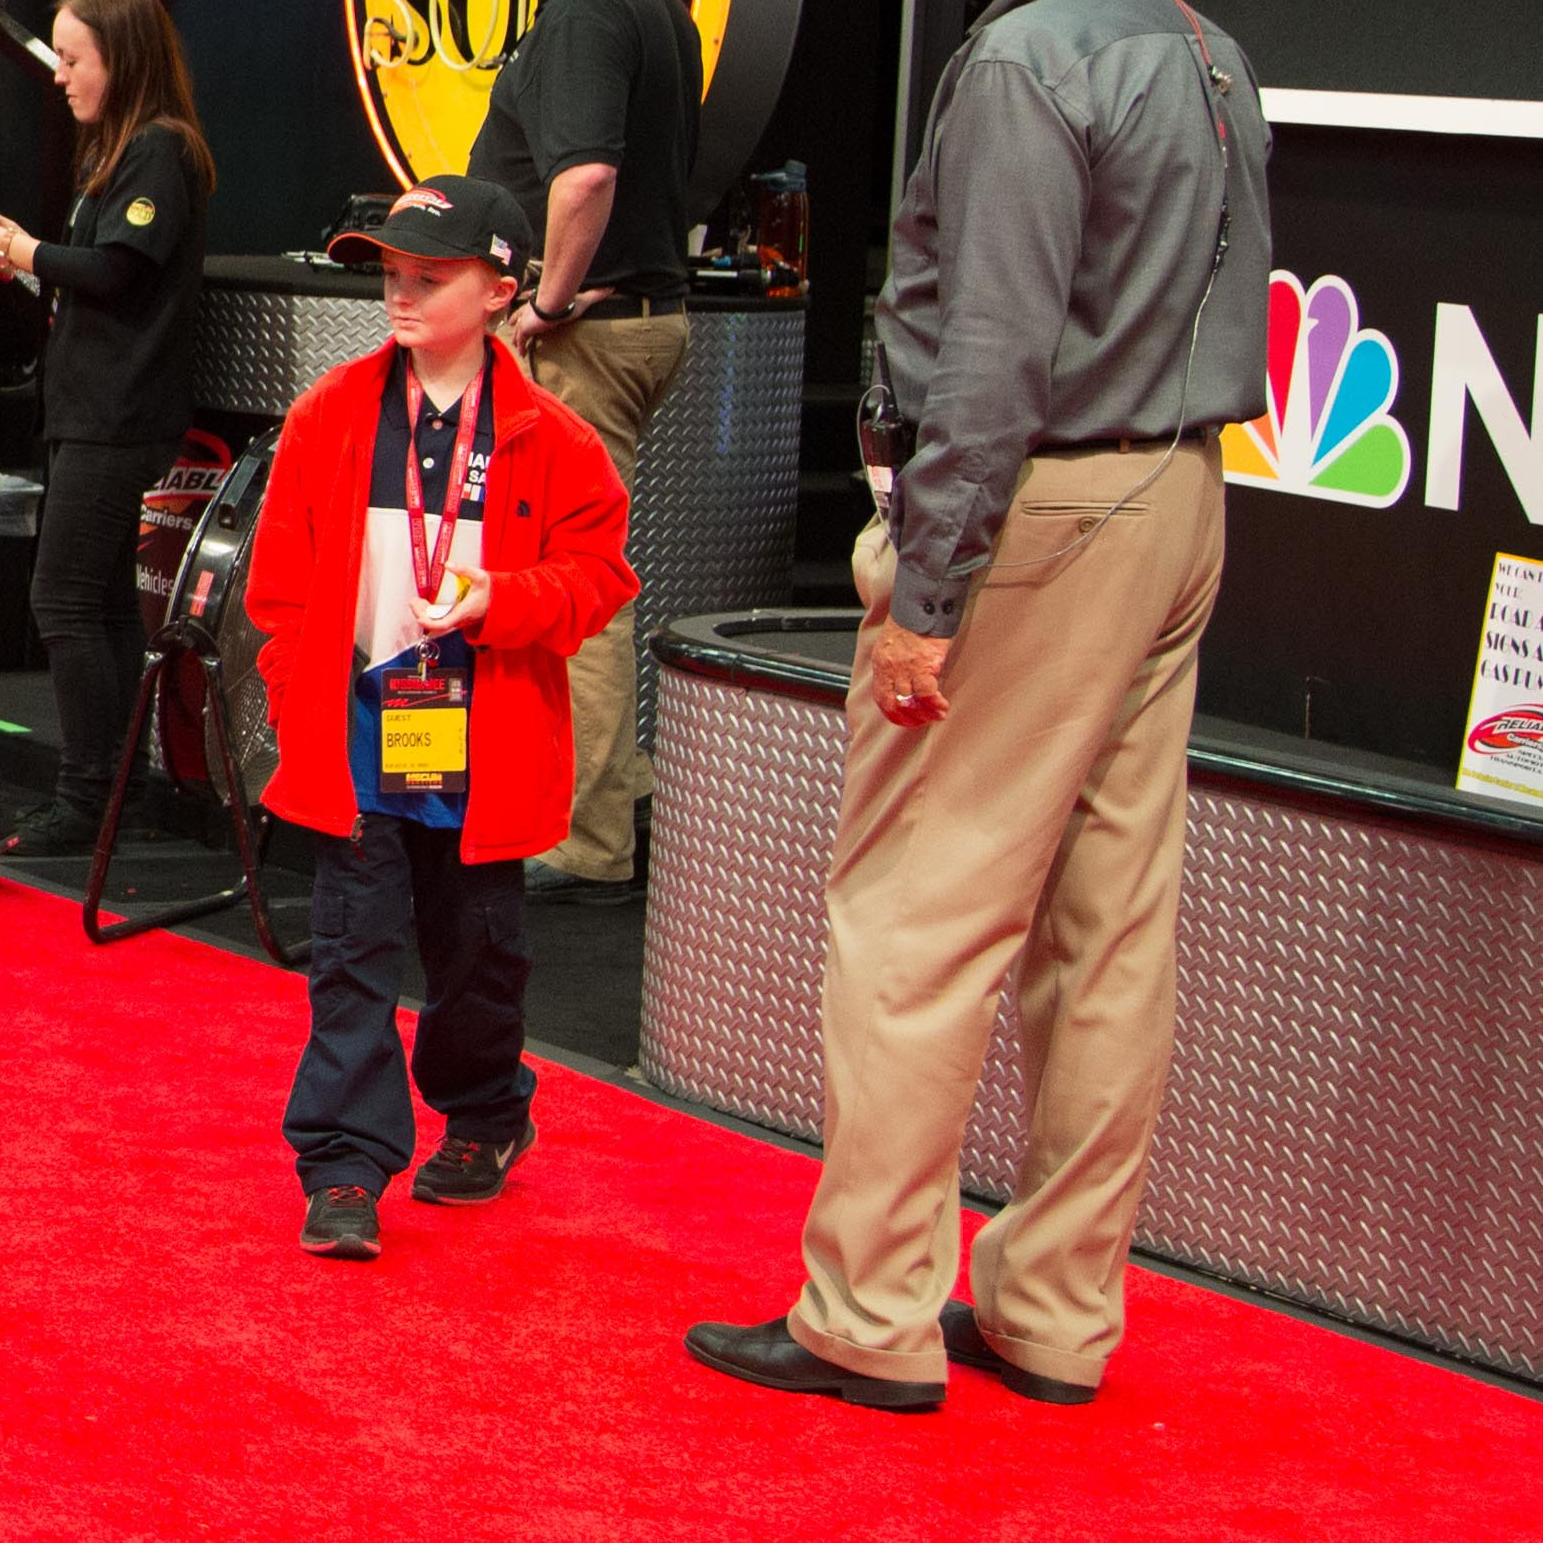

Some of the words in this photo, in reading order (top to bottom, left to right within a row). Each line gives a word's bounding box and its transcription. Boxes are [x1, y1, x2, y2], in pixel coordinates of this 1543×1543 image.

[136, 563, 175, 597] Vehicles
[1490, 602, 1532, 628] ROAD
[1486, 631, 1529, 658] SIGNS
[1481, 659, 1509, 683] GAS
[1497, 719, 1543, 732] RELIA
[387, 732, 432, 748] BROOKS
